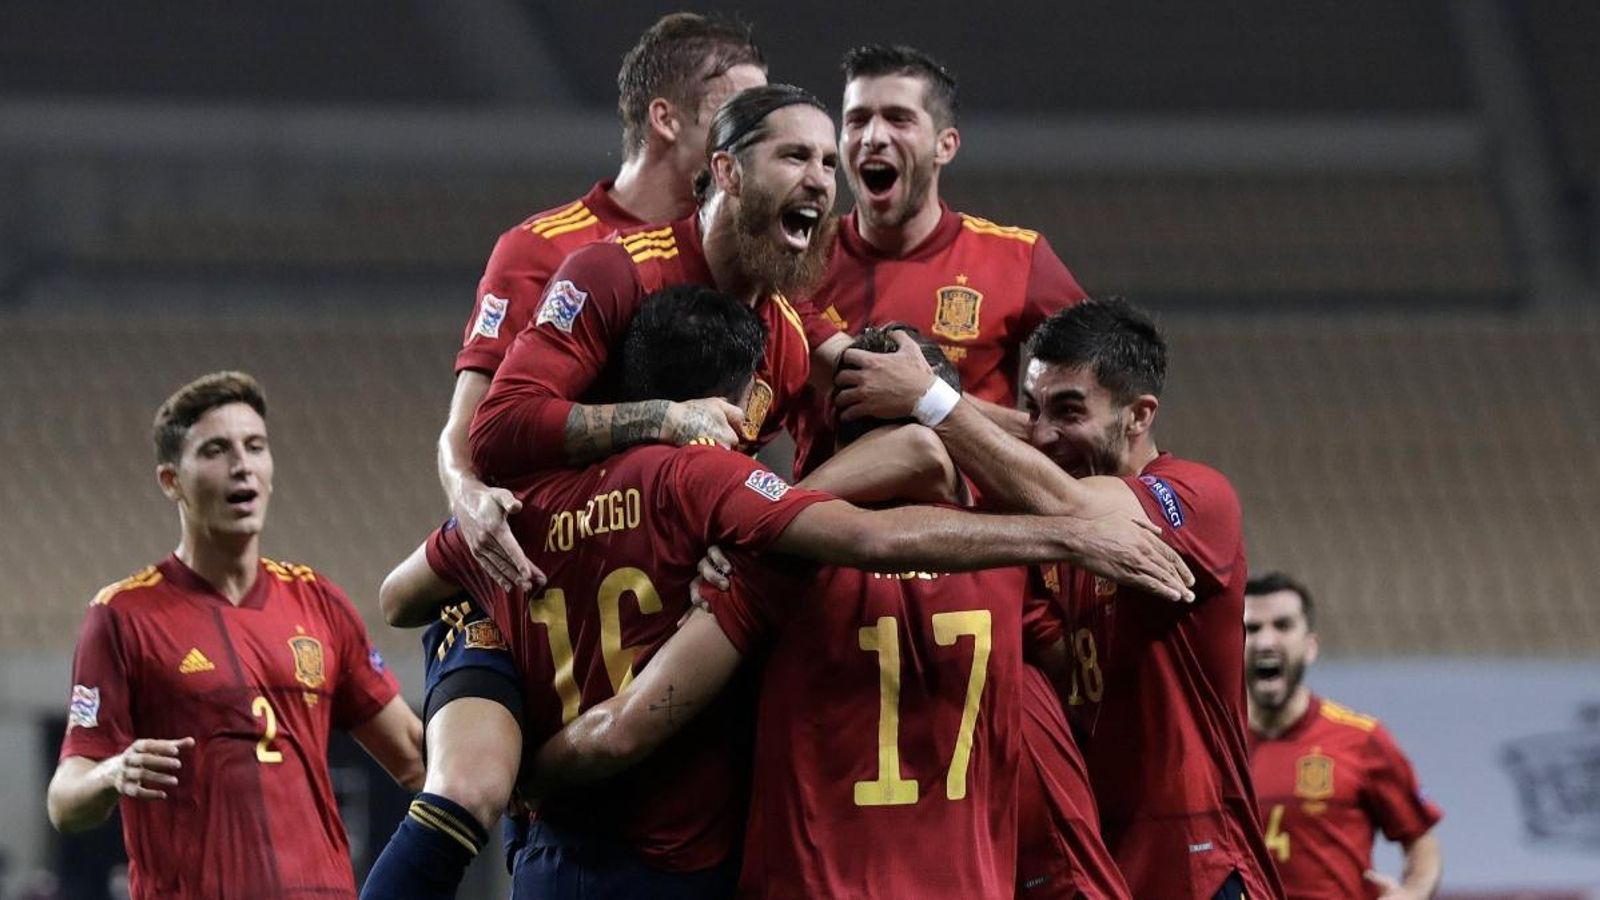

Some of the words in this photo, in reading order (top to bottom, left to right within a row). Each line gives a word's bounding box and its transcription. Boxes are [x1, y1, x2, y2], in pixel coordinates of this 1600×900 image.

[1153, 482, 1181, 527] RESPECT
[529, 566, 663, 725] 16
[252, 696, 283, 763] 2
[854, 609, 992, 805] 17
[1265, 804, 1291, 862] 4
